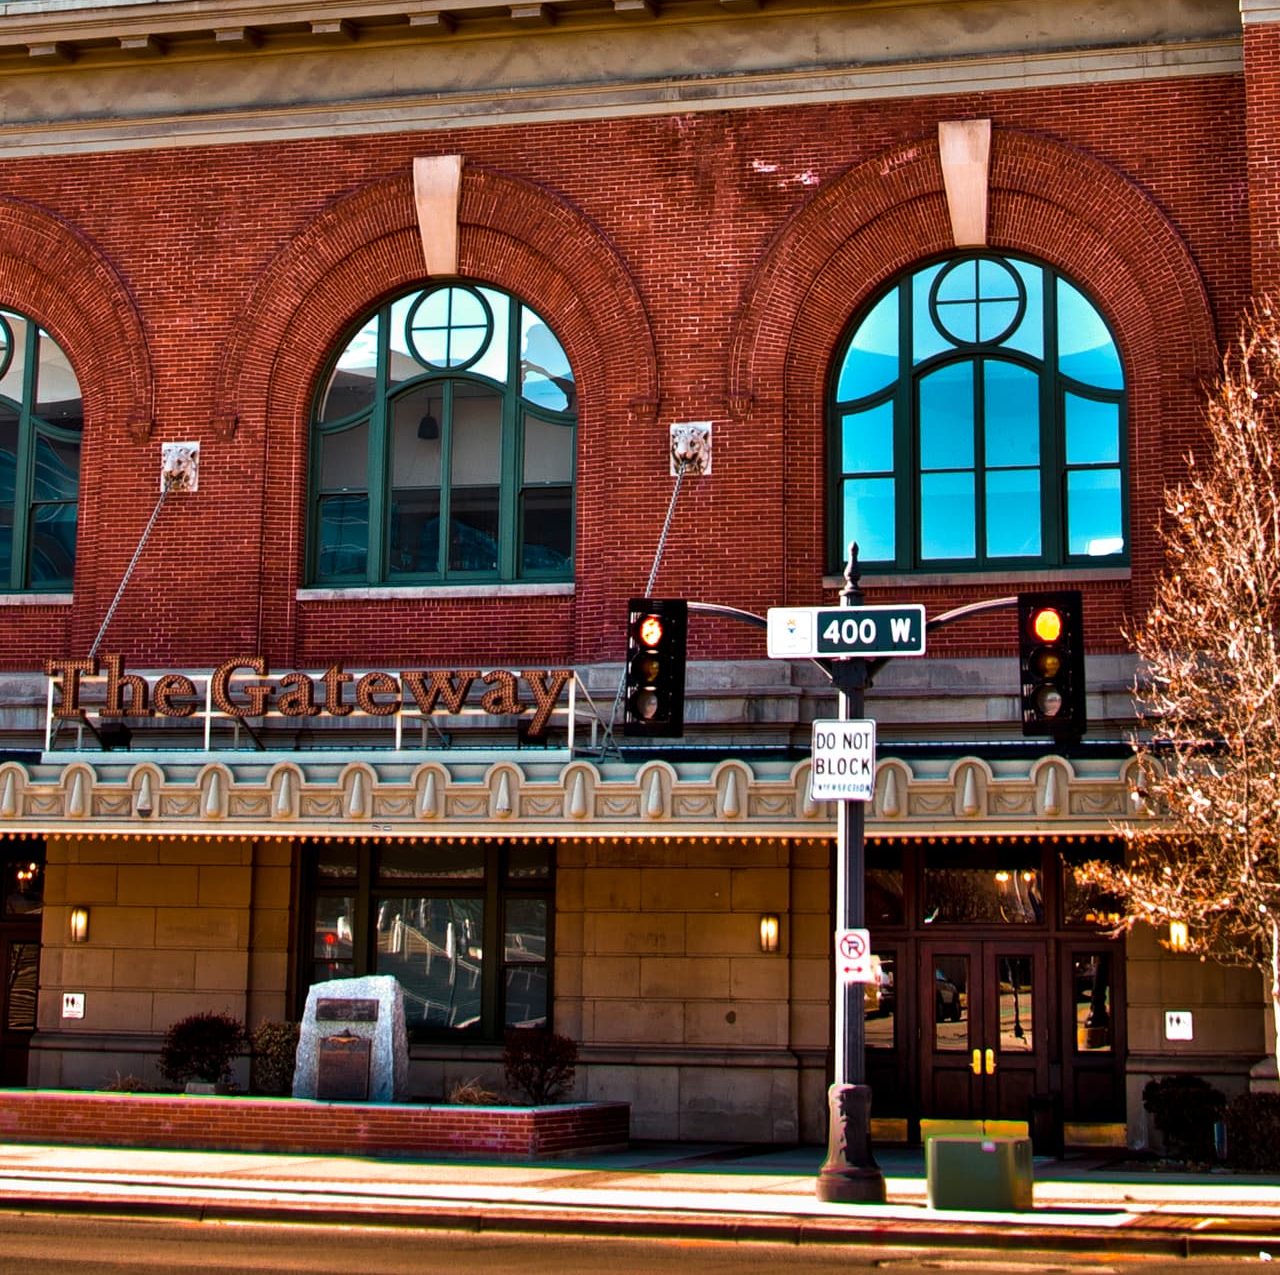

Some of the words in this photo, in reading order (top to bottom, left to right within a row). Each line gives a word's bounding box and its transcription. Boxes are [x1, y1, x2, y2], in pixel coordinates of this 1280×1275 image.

[823, 618, 877, 645] 400
[890, 618, 916, 643] W.
[42, 654, 199, 718] The
[210, 655, 575, 737] Gateway
[816, 732, 836, 750] DO
[843, 732, 870, 750] NOT
[815, 758, 871, 776] BLOCK
